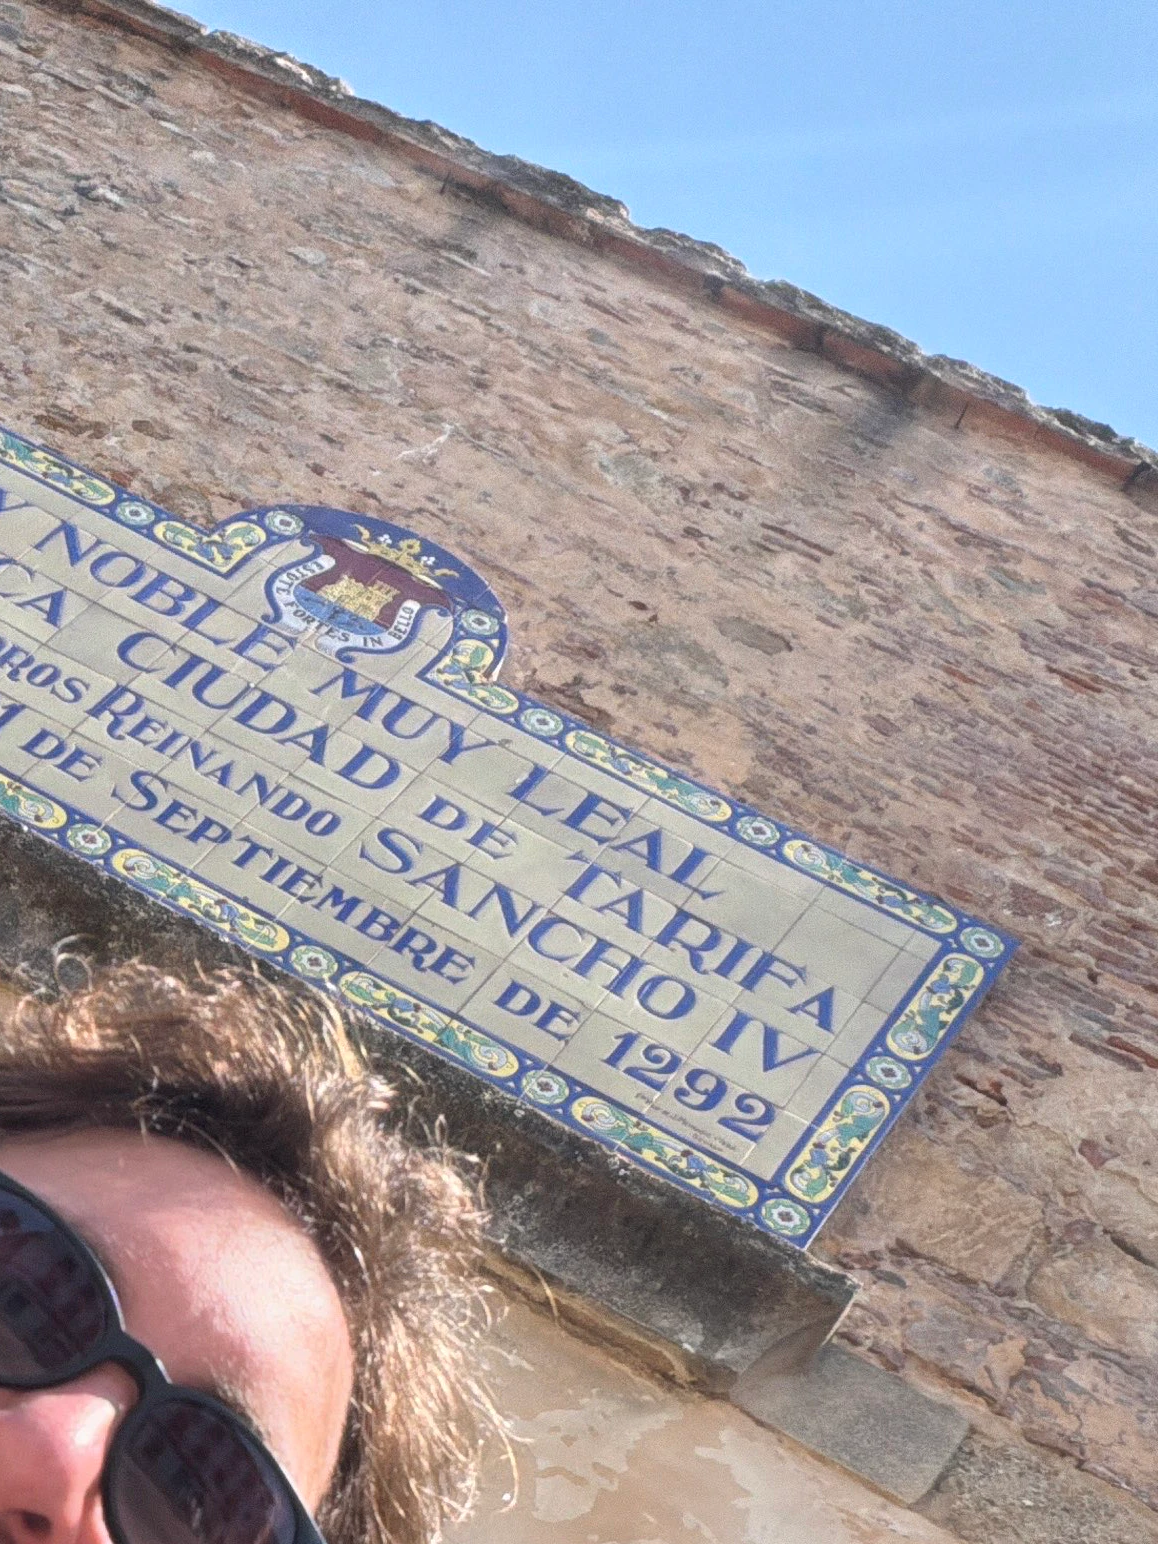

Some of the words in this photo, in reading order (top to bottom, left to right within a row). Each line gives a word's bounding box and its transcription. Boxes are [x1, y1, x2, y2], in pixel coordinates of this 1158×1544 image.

[32, 520, 299, 672] NOBLE
[308, 667, 498, 766] MUY
[506, 763, 725, 900] LEAL
[283, 599, 351, 643] FORTES
[363, 636, 384, 648] IN
[388, 606, 413, 641] BELLO
[19, 727, 104, 783] DE
[111, 770, 476, 984] SEPTIEMBRE
[492, 979, 584, 1044] DE
[598, 1031, 778, 1144] 1292
[84, 683, 342, 837] REINANDO
[358, 826, 696, 1021] SANCHO
[709, 1010, 824, 1073] IV
[117, 630, 402, 790] CIUDAD
[416, 795, 519, 860] DE
[562, 853, 838, 1034] TARIFA
